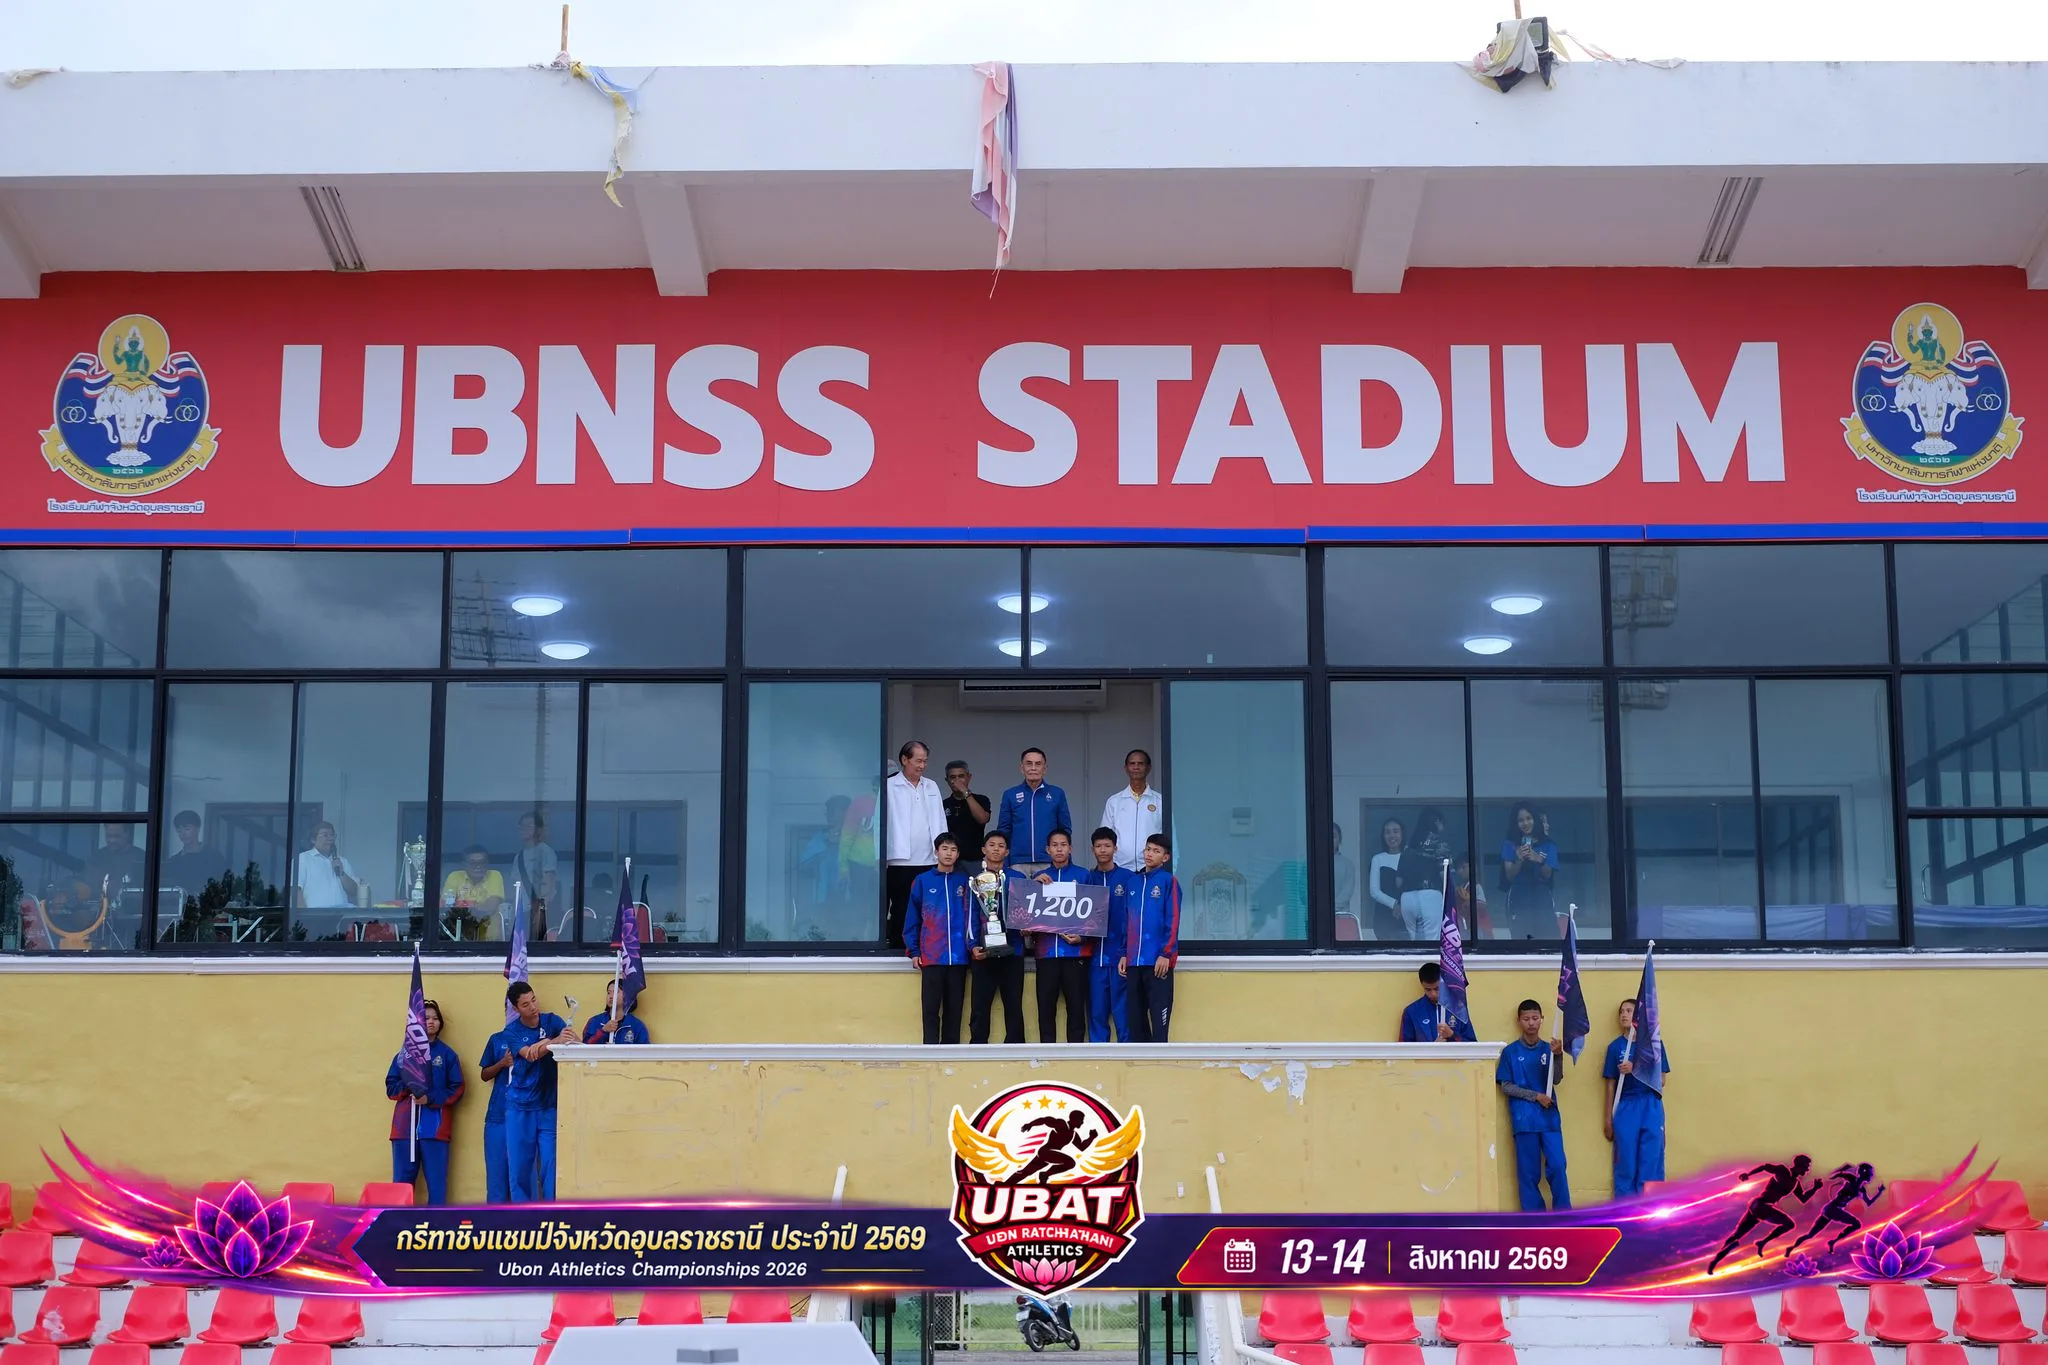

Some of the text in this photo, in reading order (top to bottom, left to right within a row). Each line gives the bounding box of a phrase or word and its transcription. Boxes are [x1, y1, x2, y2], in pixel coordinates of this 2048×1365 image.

[280, 342, 1785, 490] UBNSS STADIUM
[1865, 442, 2004, 479] มหาวิทยาลัยการกีฬาแห่งชาติ
[1025, 892, 1093, 919] 1,200
